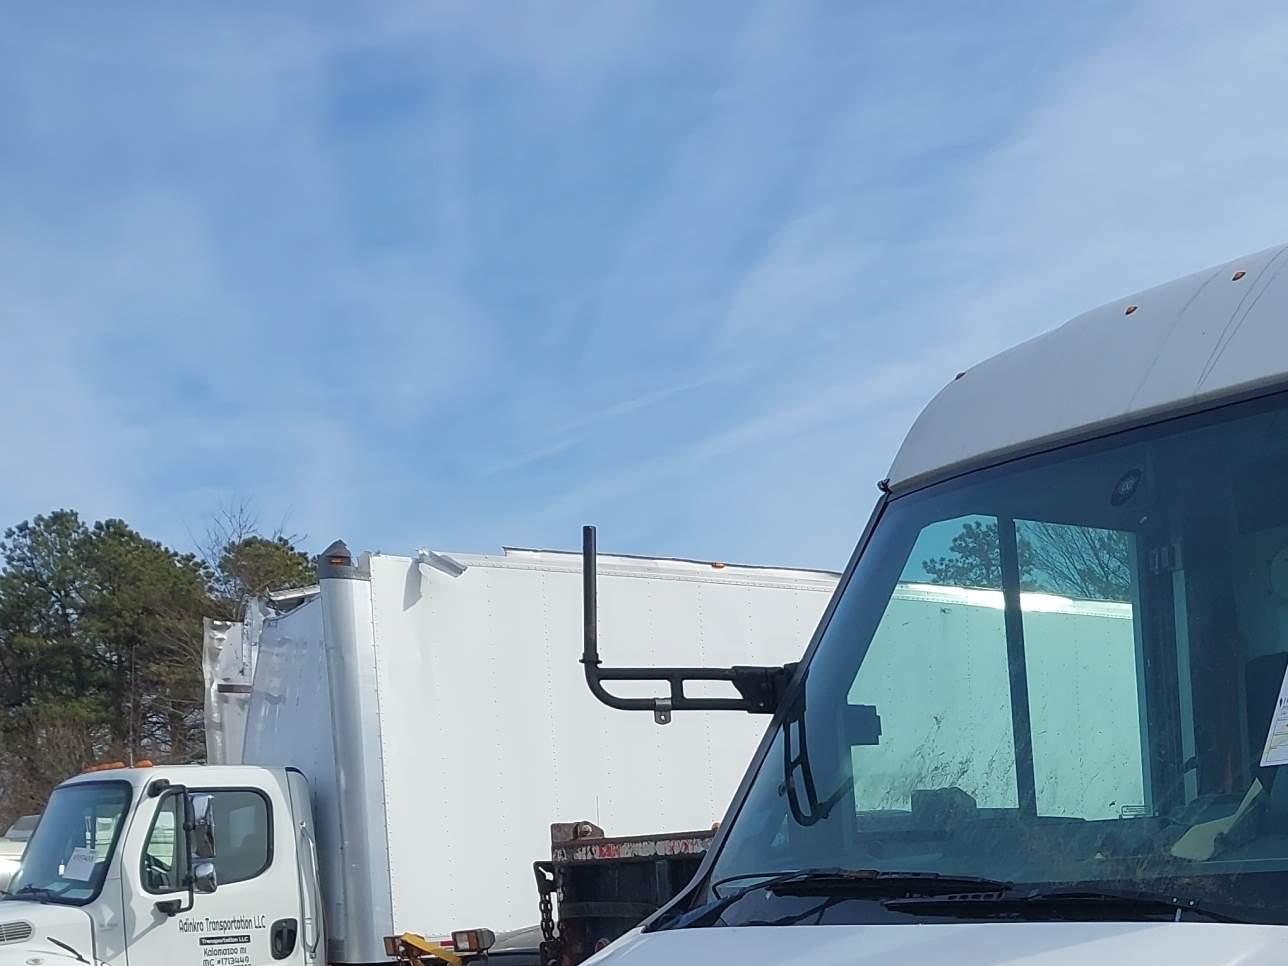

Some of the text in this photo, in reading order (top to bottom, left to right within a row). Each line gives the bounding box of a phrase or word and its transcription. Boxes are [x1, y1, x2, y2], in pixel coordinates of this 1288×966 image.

[179, 915, 266, 934] Adinkra Transportation LLC
